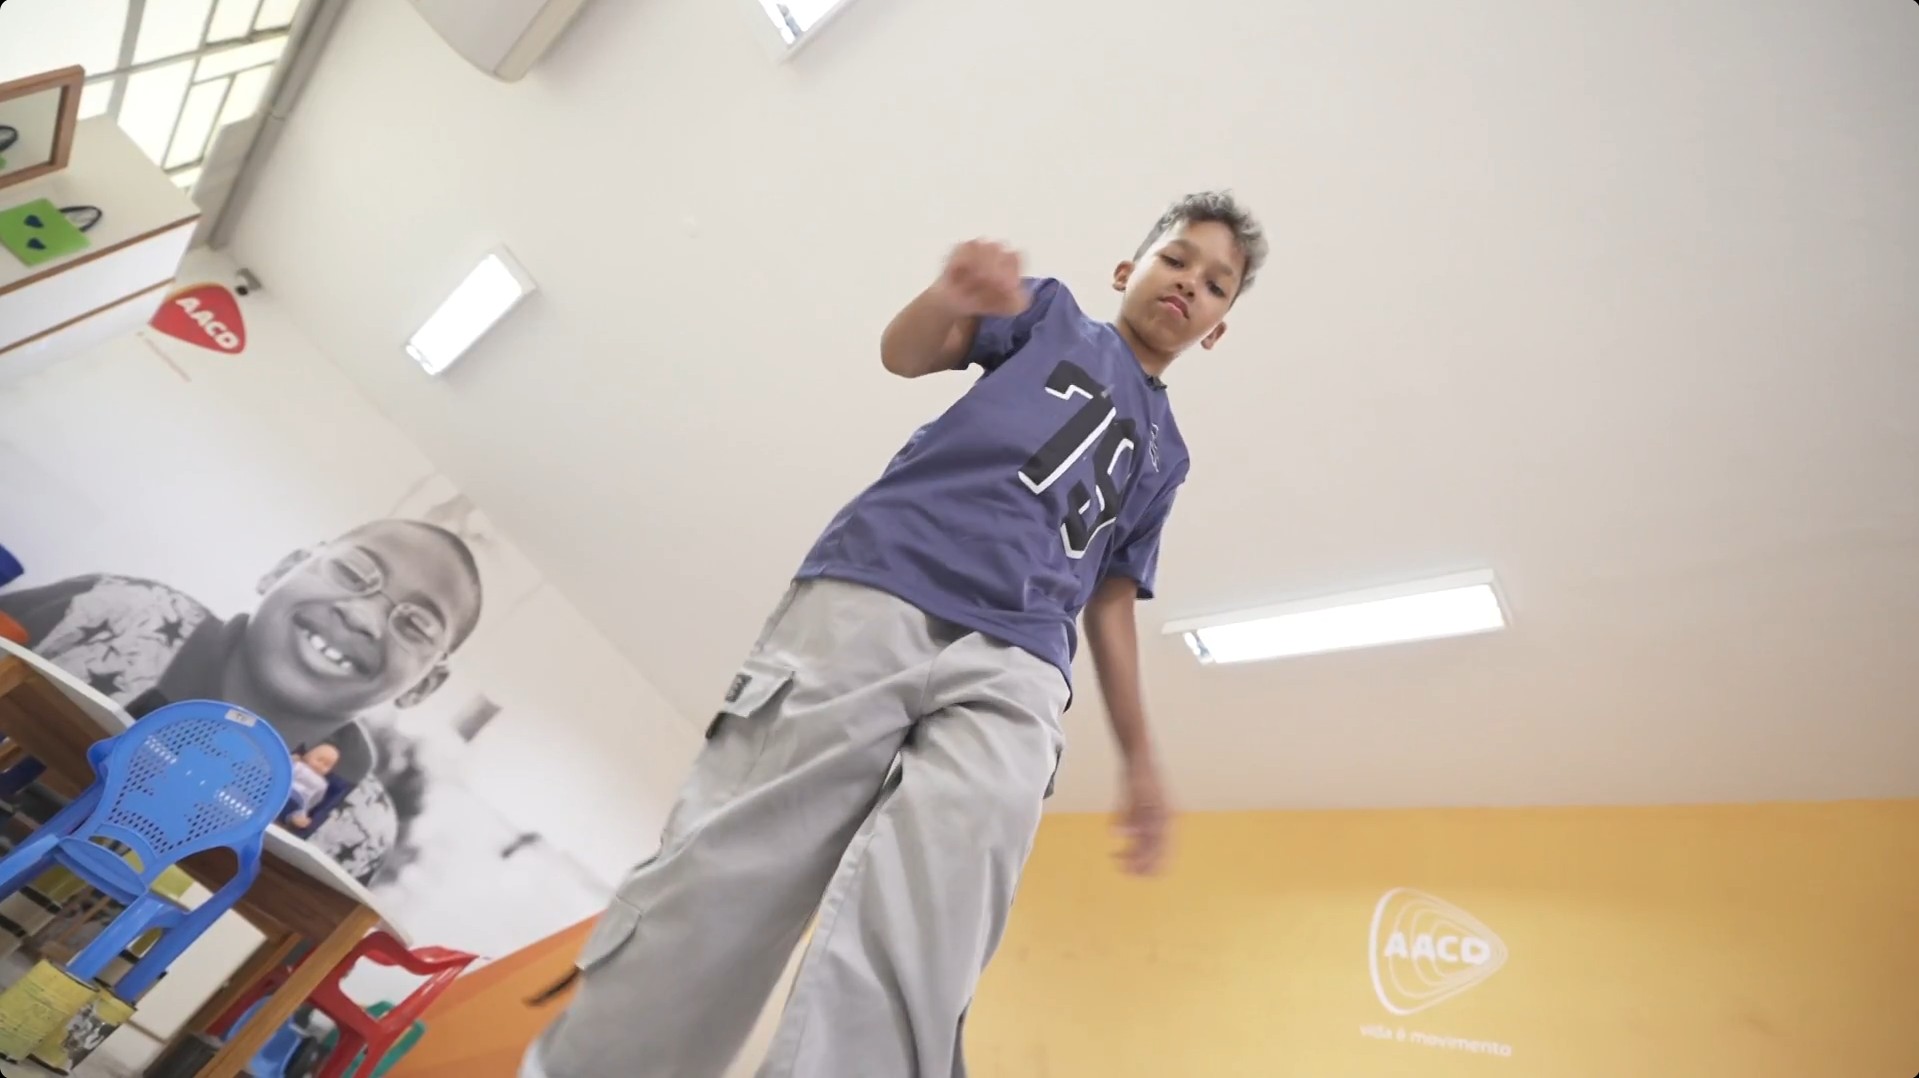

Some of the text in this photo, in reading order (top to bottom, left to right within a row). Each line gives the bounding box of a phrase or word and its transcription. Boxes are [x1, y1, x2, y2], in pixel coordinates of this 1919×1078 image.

[175, 297, 239, 349] AACD
[1384, 931, 1491, 965] AACD
[1410, 1031, 1513, 1057] movimento
